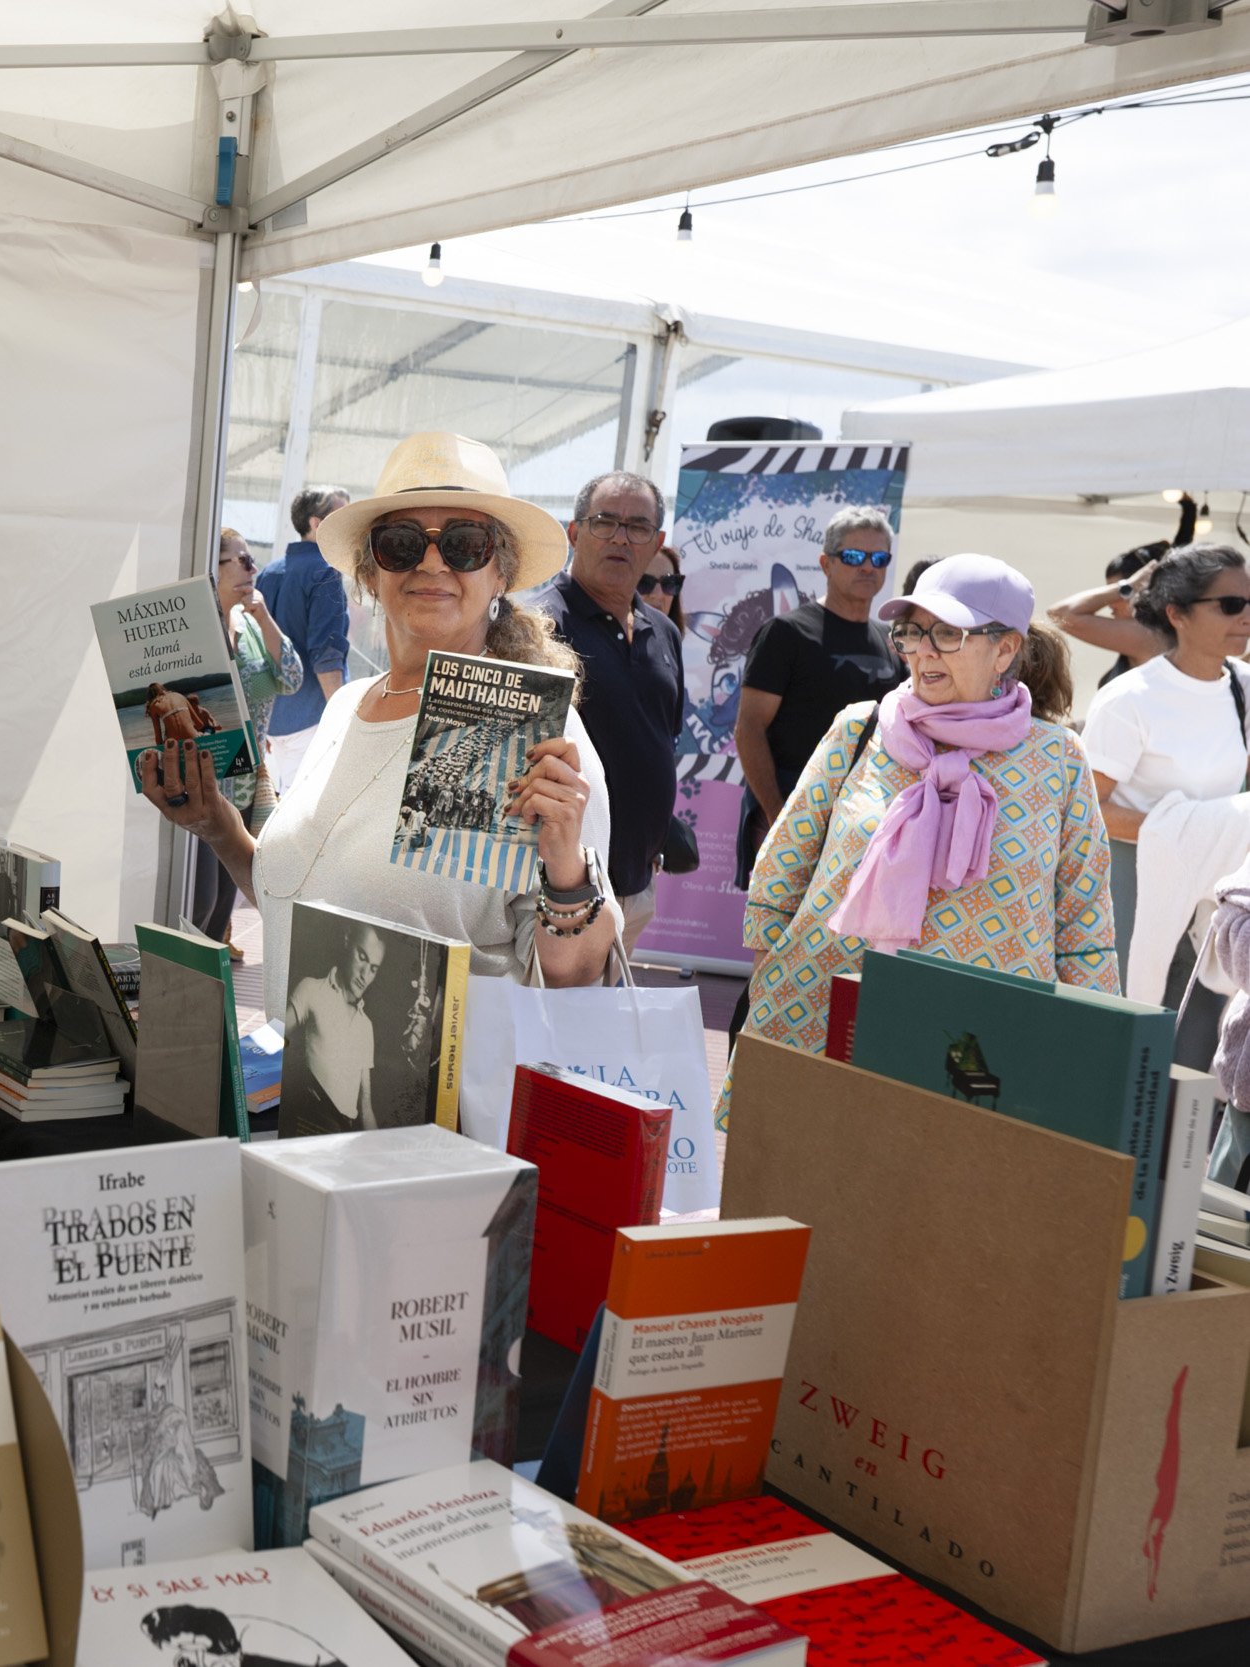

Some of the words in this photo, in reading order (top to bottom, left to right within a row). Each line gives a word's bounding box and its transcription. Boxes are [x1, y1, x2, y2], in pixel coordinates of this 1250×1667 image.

[680, 530, 717, 559] El
[721, 524, 759, 551] viaje
[763, 513, 786, 538] de
[793, 515, 824, 545] Sha
[117, 596, 186, 625] MÁXIMO
[124, 617, 190, 643] HUERTA
[143, 640, 181, 659] Mamá
[128, 661, 152, 679] está
[154, 653, 203, 674] dormida
[433, 659, 459, 677] LOS
[462, 664, 502, 685] CINCO
[505, 672, 524, 689] DE
[426, 703, 437, 712] de
[428, 696, 481, 712] Lanzaroteños
[429, 676, 542, 713] MAUTHAUSEN
[424, 713, 446, 724] Pedro
[446, 717, 467, 729] Mayo
[598, 1065, 637, 1087] LA
[1134, 1046, 1149, 1118] estelares
[1144, 1071, 1160, 1156] humanidad
[667, 1137, 695, 1159] O
[1130, 1121, 1143, 1158] ntos
[665, 1161, 698, 1174] OTE
[1138, 1162, 1148, 1179] la
[98, 1172, 146, 1192] Ifrabe
[1136, 1181, 1146, 1200] de
[46, 1213, 157, 1248] TIRADOS
[163, 1210, 193, 1233] EN
[56, 1258, 91, 1285] EL
[97, 1247, 193, 1279] PUENTE
[48, 1288, 90, 1304] Memorias
[92, 1286, 116, 1298] reales
[117, 1283, 127, 1292] de
[128, 1283, 139, 1291] un
[140, 1279, 167, 1290] librero
[168, 1273, 204, 1286] diabético
[83, 1302, 89, 1313] y
[90, 1302, 100, 1311] su
[102, 1297, 138, 1311] ayudante
[139, 1291, 172, 1304] barbudo
[390, 1291, 470, 1320] ROBERT
[398, 1317, 457, 1343] MUSIL
[633, 1322, 675, 1335] Manuel
[677, 1319, 717, 1331] Chaves
[719, 1312, 765, 1327] Nogales
[631, 1337, 643, 1350] El
[645, 1335, 689, 1349] maestro
[689, 1331, 715, 1346] Juan
[717, 1326, 764, 1341] Martínez
[629, 1354, 649, 1367] que
[651, 1348, 685, 1362] estaba
[385, 1379, 404, 1394] EL
[404, 1367, 462, 1391] HOMBRE
[411, 1391, 435, 1407] SIN
[382, 1403, 459, 1430] ATRIBUTOS
[798, 1380, 947, 1481] ZWEIG
[854, 1455, 879, 1477] en
[359, 1508, 428, 1537] Eduardo
[427, 1488, 499, 1513] Mendoza
[770, 1438, 996, 1579] CANTILADO
[375, 1535, 399, 1549] La
[400, 1519, 446, 1543] intriga
[446, 1509, 470, 1524] del
[394, 1521, 494, 1561] inconveniente
[725, 1549, 767, 1562] Chaves
[766, 1541, 813, 1554] Nogales
[127, 1583, 149, 1599] SI
[156, 1576, 210, 1596] SALE
